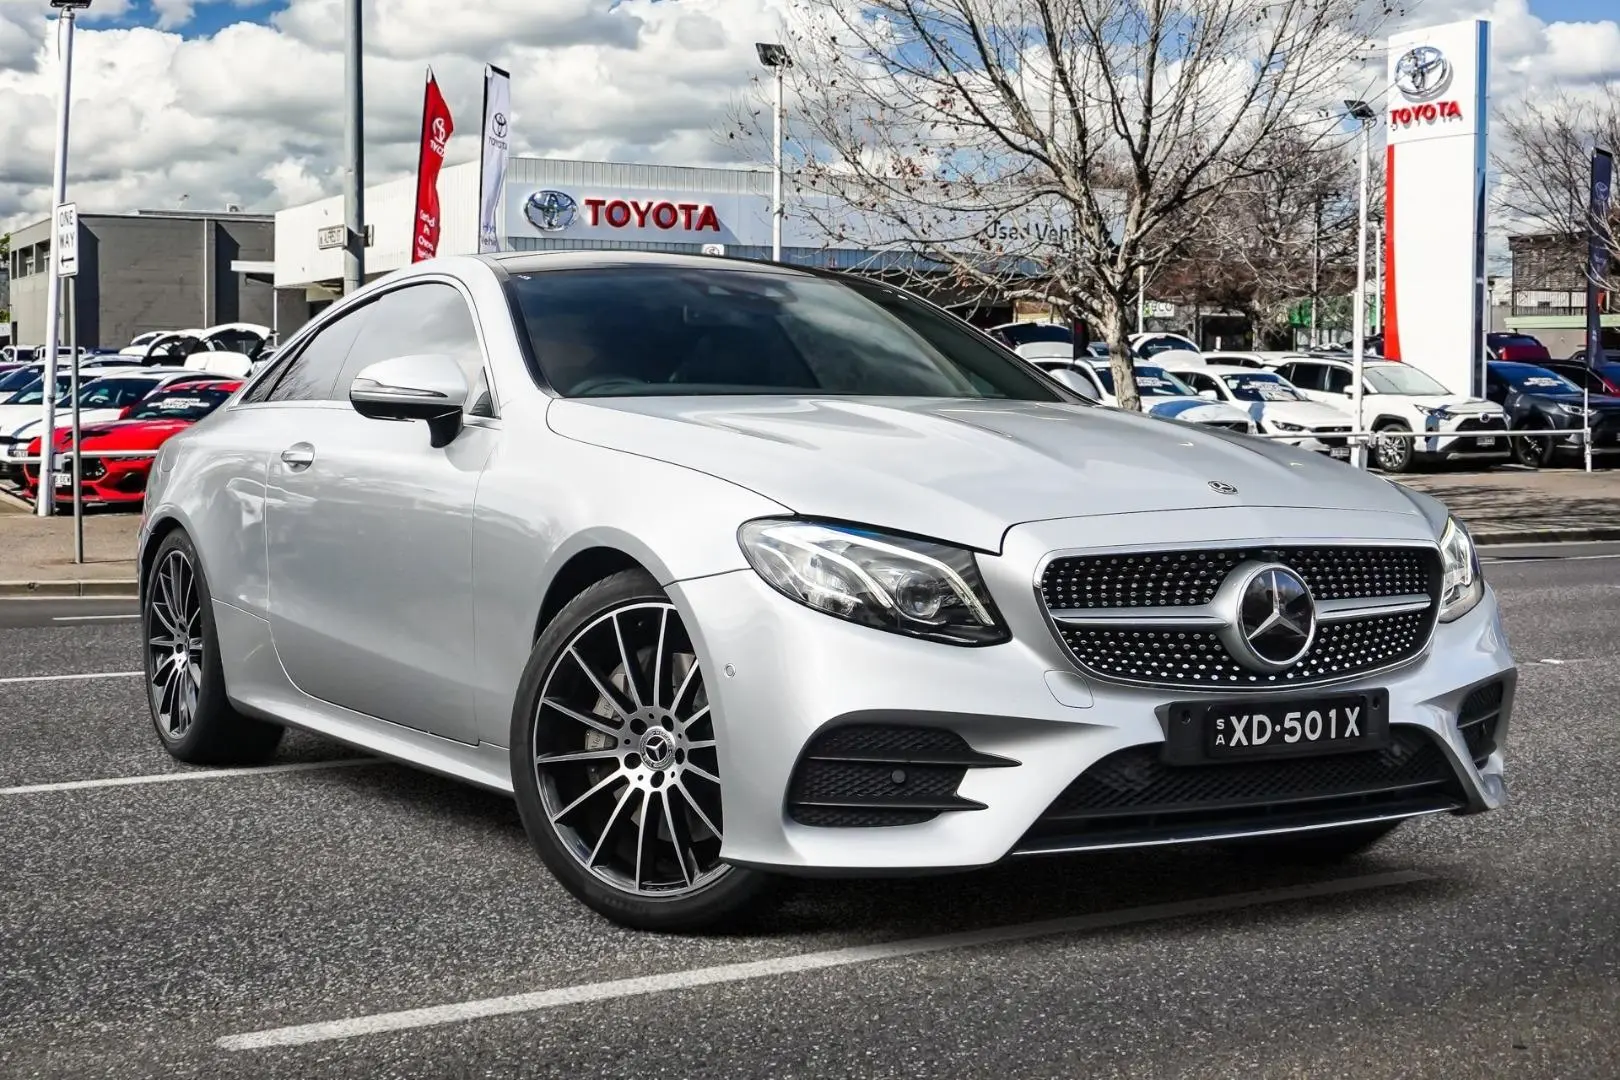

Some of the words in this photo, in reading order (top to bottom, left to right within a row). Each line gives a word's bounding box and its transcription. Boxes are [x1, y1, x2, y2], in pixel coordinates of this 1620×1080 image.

[1389, 101, 1461, 124] TOYOTA
[60, 210, 74, 227] ONE
[585, 199, 720, 232] TOYOTA
[59, 231, 75, 248] WAY
[985, 221, 1030, 241] Used
